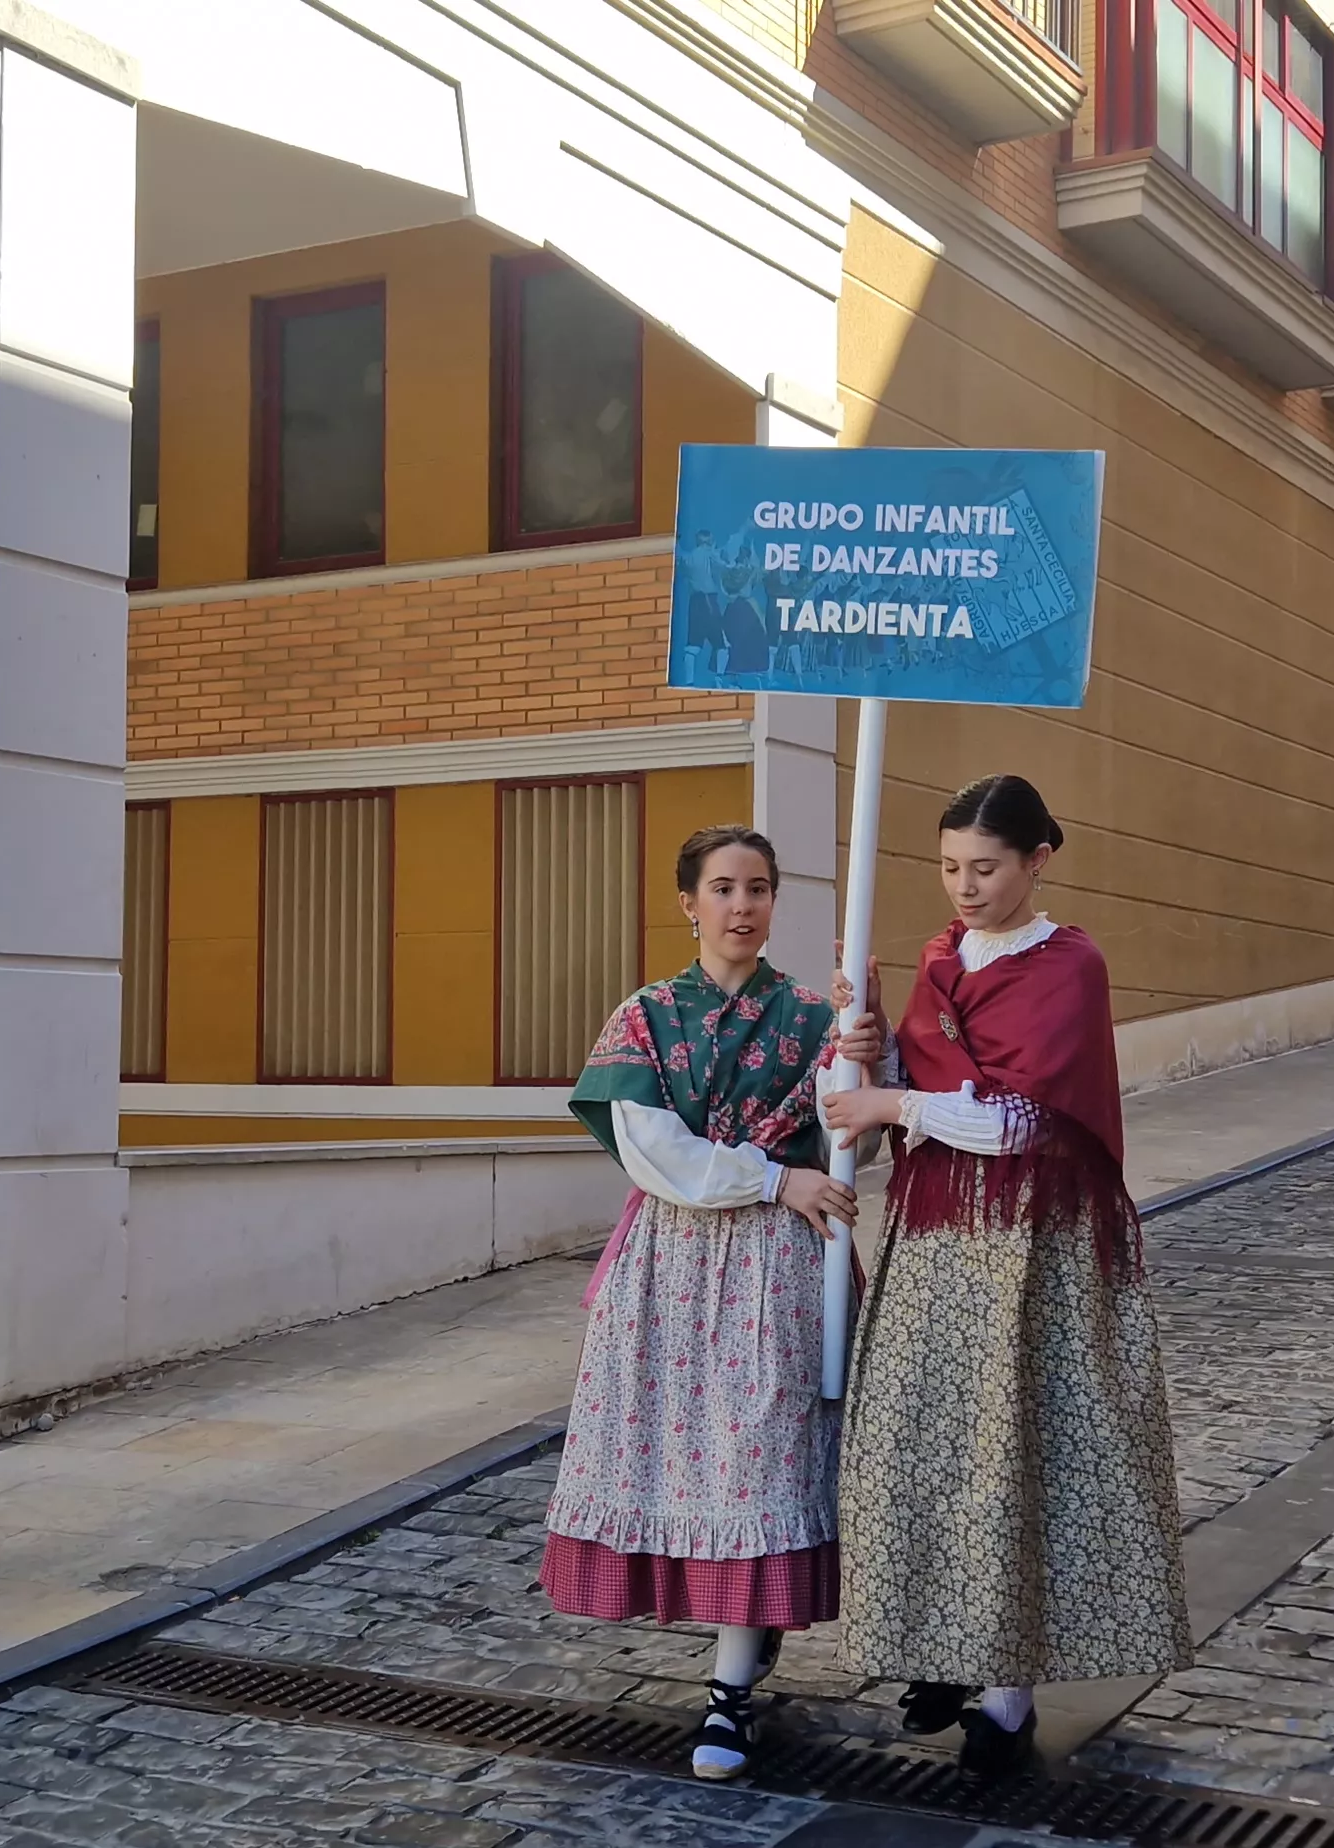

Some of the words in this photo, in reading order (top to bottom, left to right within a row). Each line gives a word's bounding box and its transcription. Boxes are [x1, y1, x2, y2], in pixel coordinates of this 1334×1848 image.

[753, 501, 864, 531] GRUPO
[875, 504, 1014, 535] INFANTIL
[764, 543, 801, 572] DE
[812, 544, 999, 579] DANZANTES
[1022, 506, 1049, 550] SANTA
[1044, 553, 1075, 604] CECILIA
[776, 598, 973, 639] TARDIENTA
